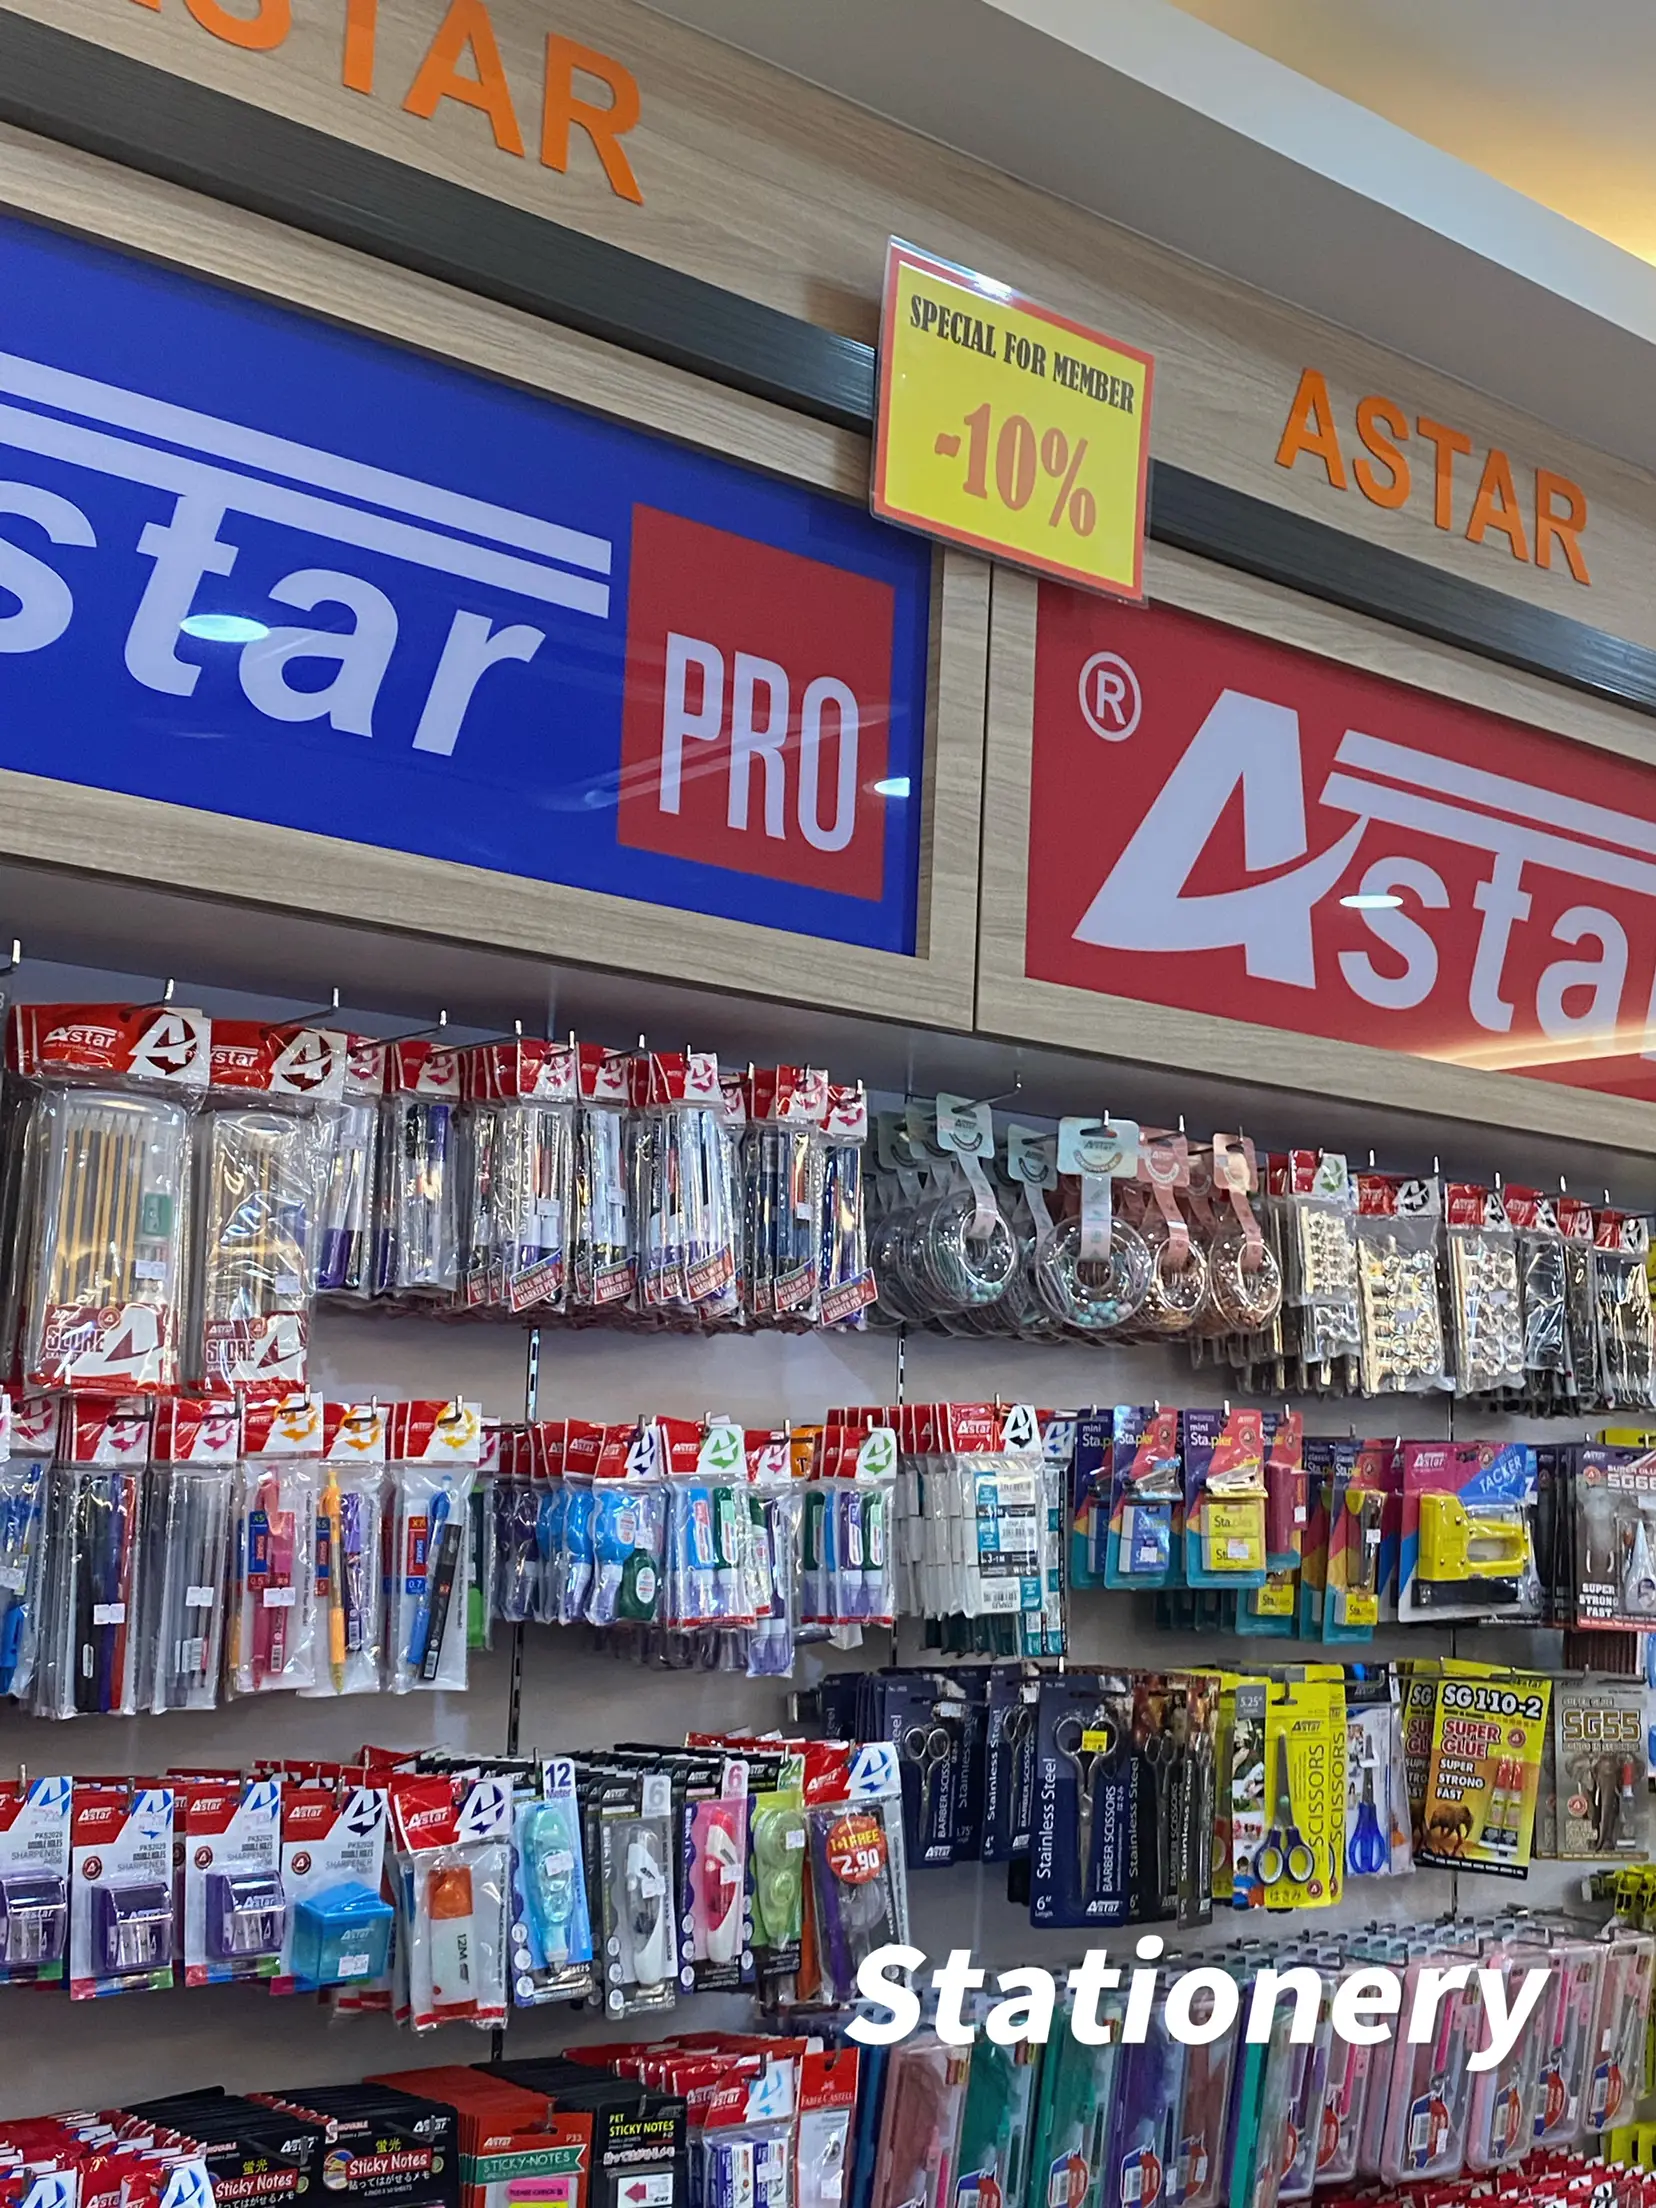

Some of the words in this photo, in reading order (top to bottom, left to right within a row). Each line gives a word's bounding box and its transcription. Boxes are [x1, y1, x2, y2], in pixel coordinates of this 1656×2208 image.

[909, 293, 997, 359] SPECIAL
[1002, 330, 1047, 378] FOR
[1052, 351, 1135, 415] MEMBER
[934, 403, 1097, 537] -10%
[1274, 368, 1592, 586] ASTAR
[658, 631, 860, 853] PRO
[1072, 688, 1656, 1061] Asta
[43, 1024, 119, 1049] Astar
[211, 1044, 259, 1068] star
[957, 1419, 992, 1436] Astar
[1082, 1424, 1102, 1433] mini
[1190, 1422, 1208, 1432] mini
[1190, 1432, 1233, 1449] Sta.pler
[1413, 1451, 1448, 1468] Astar
[1479, 1455, 1522, 1494] TACKER
[408, 1579, 422, 1589] 0.7
[1581, 1583, 1615, 1595] SUPER
[1579, 1594, 1619, 1607] STRONG
[1586, 1607, 1613, 1618] FAST
[1239, 1695, 1263, 1708] 5.25"
[1443, 1682, 1474, 1710] SG
[1473, 1686, 1544, 1719] 110-2
[989, 1709, 1001, 1749] Steel
[1291, 1719, 1324, 1732] Astar
[1443, 1718, 1501, 1743] SUPER
[1562, 1708, 1642, 1743] SG55
[1441, 1733, 1489, 1760] GLUE
[545, 1763, 571, 1788] 12
[727, 1764, 743, 1787] 6
[941, 1753, 950, 1793] SCISSO
[1129, 1756, 1139, 1800] Steel
[1439, 1758, 1475, 1774] SUPER
[987, 1750, 999, 1821] Stainless
[1041, 1757, 1057, 1800] Steel
[1184, 1759, 1193, 1801] Steel
[1330, 1732, 1346, 1845] SCISSORS
[1438, 1773, 1485, 1789] STRONG
[546, 1788, 572, 1799] Meter
[649, 1780, 665, 1808] 6
[1308, 1744, 1325, 1848] SCISSORS
[1435, 1786, 1464, 1801] FAST
[77, 1806, 114, 1823] Astar
[190, 1799, 223, 1814] Astar
[288, 1804, 323, 1819] Astar
[937, 1794, 949, 1839] BARBER
[1104, 1785, 1117, 1843] SCISSORS
[405, 1807, 448, 1831] Astar
[849, 1829, 880, 1848] FREE
[1036, 1800, 1054, 1880] Stainless
[1128, 1800, 1139, 1878] Stainless
[1181, 1801, 1190, 1882] Stainless
[11, 1849, 63, 1861] SHARPENER
[117, 1860, 166, 1872] SHARPENER
[226, 1851, 273, 1862] SHARPENER
[325, 1858, 373, 1868] SHARPENER
[1103, 1843, 1115, 1892] BARBER
[243, 1895, 277, 1908] Astar
[1036, 1896, 1053, 1910] 6"
[1085, 1900, 1122, 1913] Astar
[457, 1933, 468, 1961] 12M
[608, 2123, 642, 2137] STICKY
[643, 2120, 675, 2133] NOTES
[609, 2113, 624, 2124] PET
[349, 2158, 389, 2176] Sticky
[391, 2152, 428, 2168] Notes
[483, 2150, 571, 2174] STICKY-NOTES
[215, 2181, 255, 2198] Sticky
[256, 2173, 294, 2191] Notes
